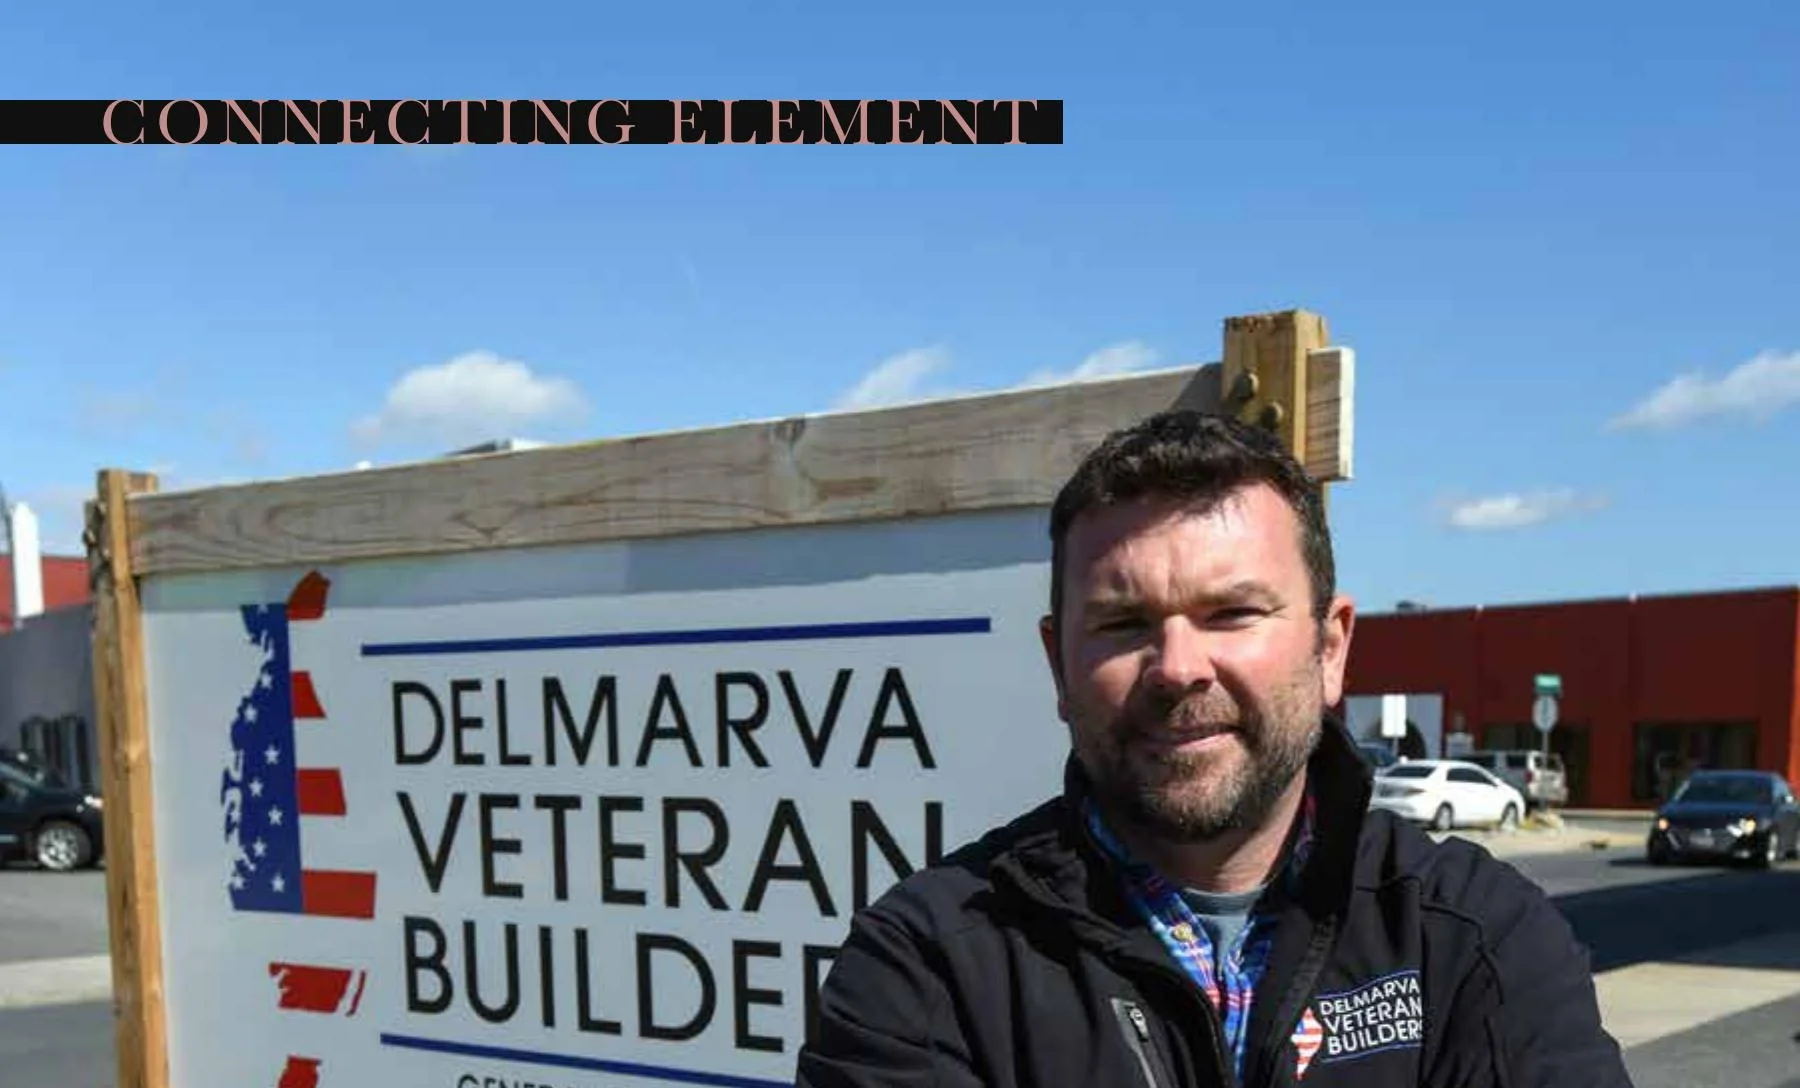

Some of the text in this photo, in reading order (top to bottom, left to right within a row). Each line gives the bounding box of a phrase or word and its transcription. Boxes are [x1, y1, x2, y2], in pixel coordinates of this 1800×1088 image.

[392, 668, 936, 769] DELMARVA
[396, 792, 942, 917] VETERAN
[1320, 977, 1420, 1016] DELMARVA
[1323, 996, 1422, 1034] VETERAN
